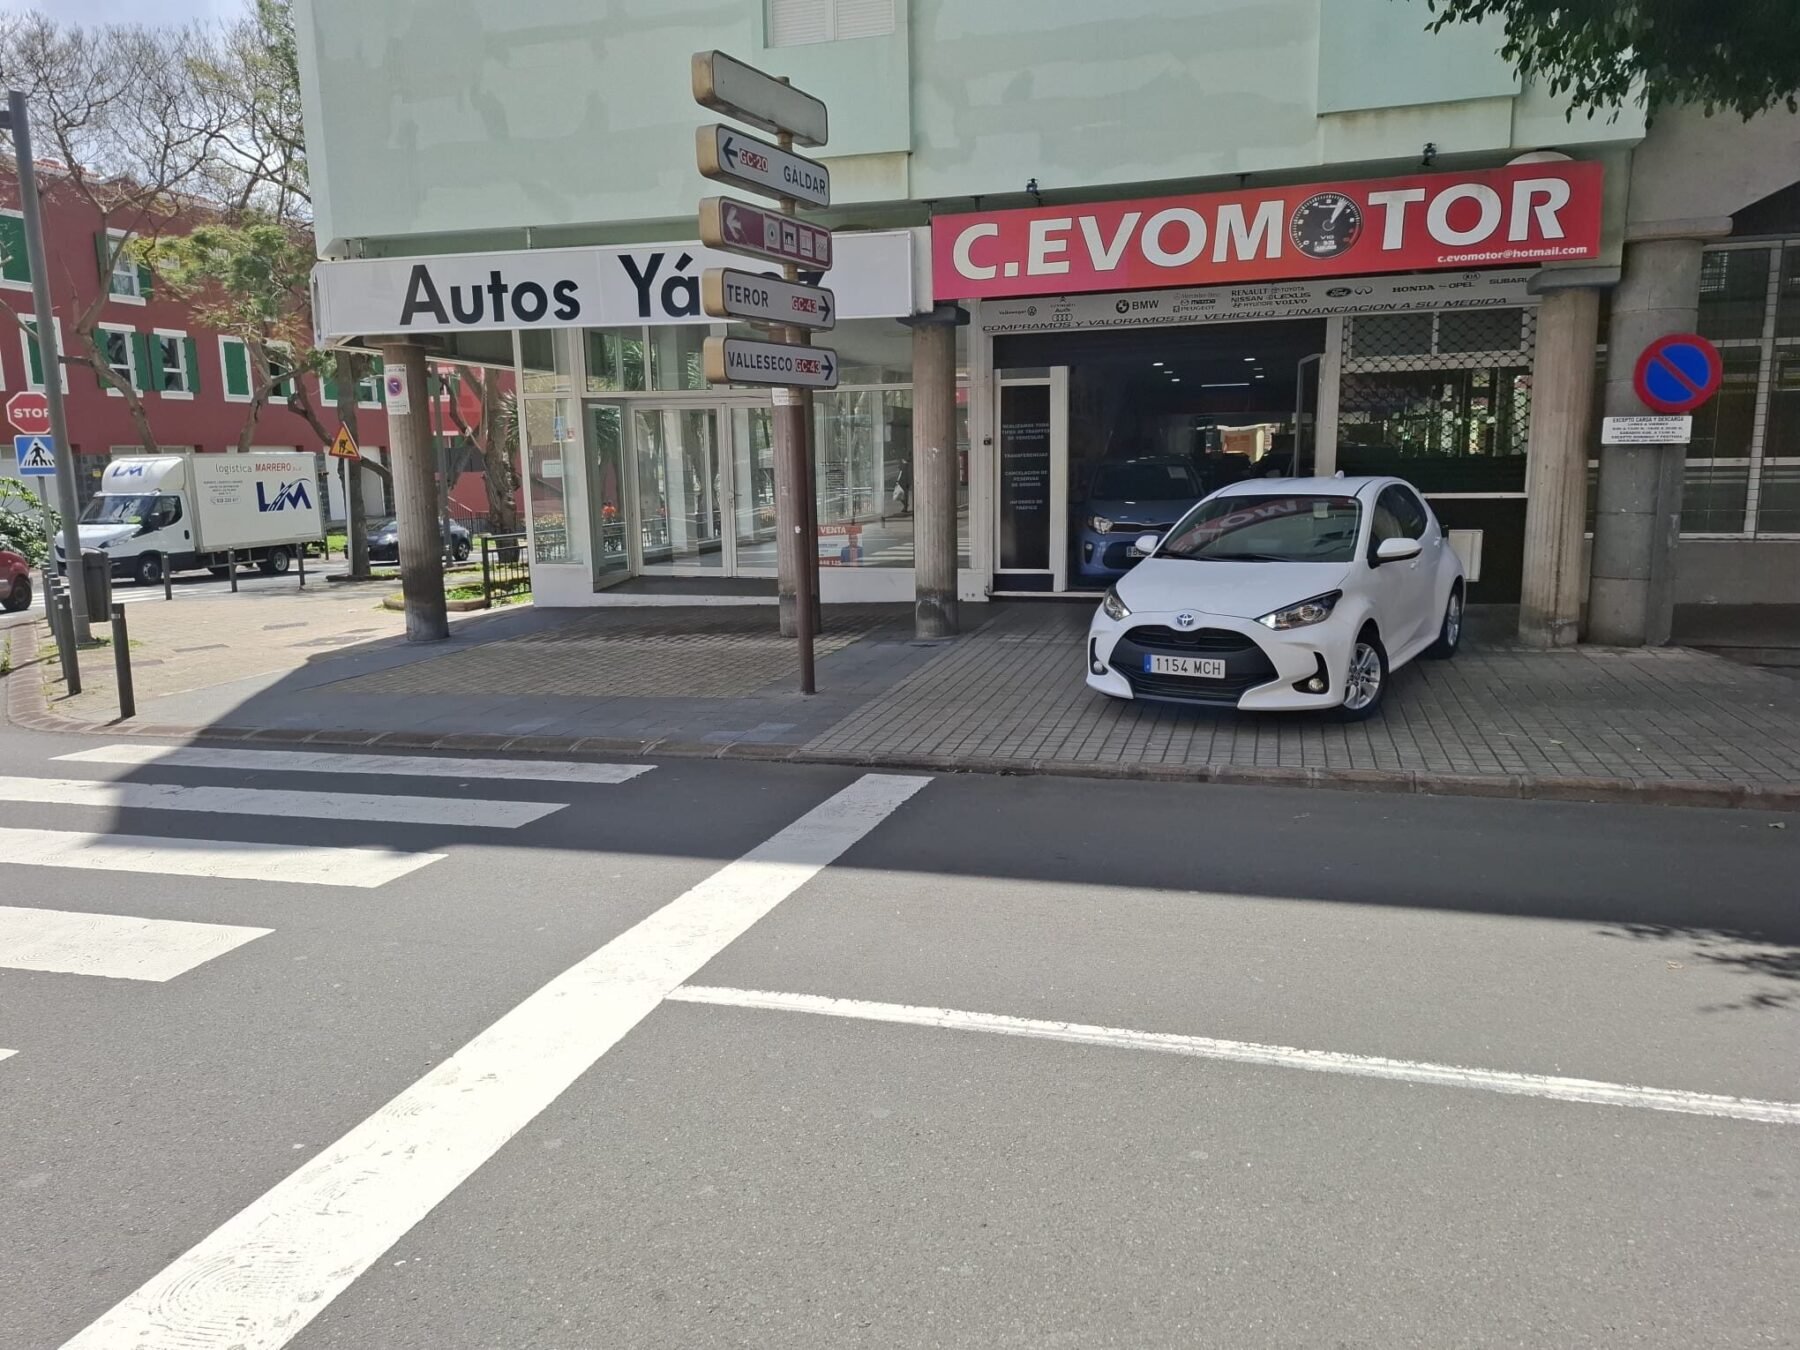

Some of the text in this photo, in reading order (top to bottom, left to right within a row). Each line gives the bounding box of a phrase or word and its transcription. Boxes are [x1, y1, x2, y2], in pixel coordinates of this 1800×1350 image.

[739, 150, 826, 195] GC-20 GÁLDAR
[1437, 246, 1588, 263] c.evomotor@hotmail.com
[1231, 288, 1267, 297] RENAULT
[1392, 284, 1435, 293] HONDA
[1448, 281, 1475, 289] OPEL
[400, 264, 580, 325] Autos
[727, 284, 817, 313] TEROR GC-43
[1132, 300, 1159, 311] BMW
[982, 321, 1071, 332] COMPRAMOS
[1076, 320, 1084, 328] Y
[1088, 315, 1174, 327] VALORAMOS
[1179, 314, 1198, 322] SU
[1204, 310, 1276, 321] VEHICULO
[1286, 302, 1397, 317] FINANCIACION
[1400, 302, 1412, 310] A
[1415, 300, 1438, 309] SU
[1445, 297, 1507, 308] MEDIDA
[728, 351, 820, 374] VALLESECO GC-43
[255, 463, 291, 472] MARRERO
[820, 526, 846, 534] VENTA
[1156, 657, 1221, 676] 1154 MCH
